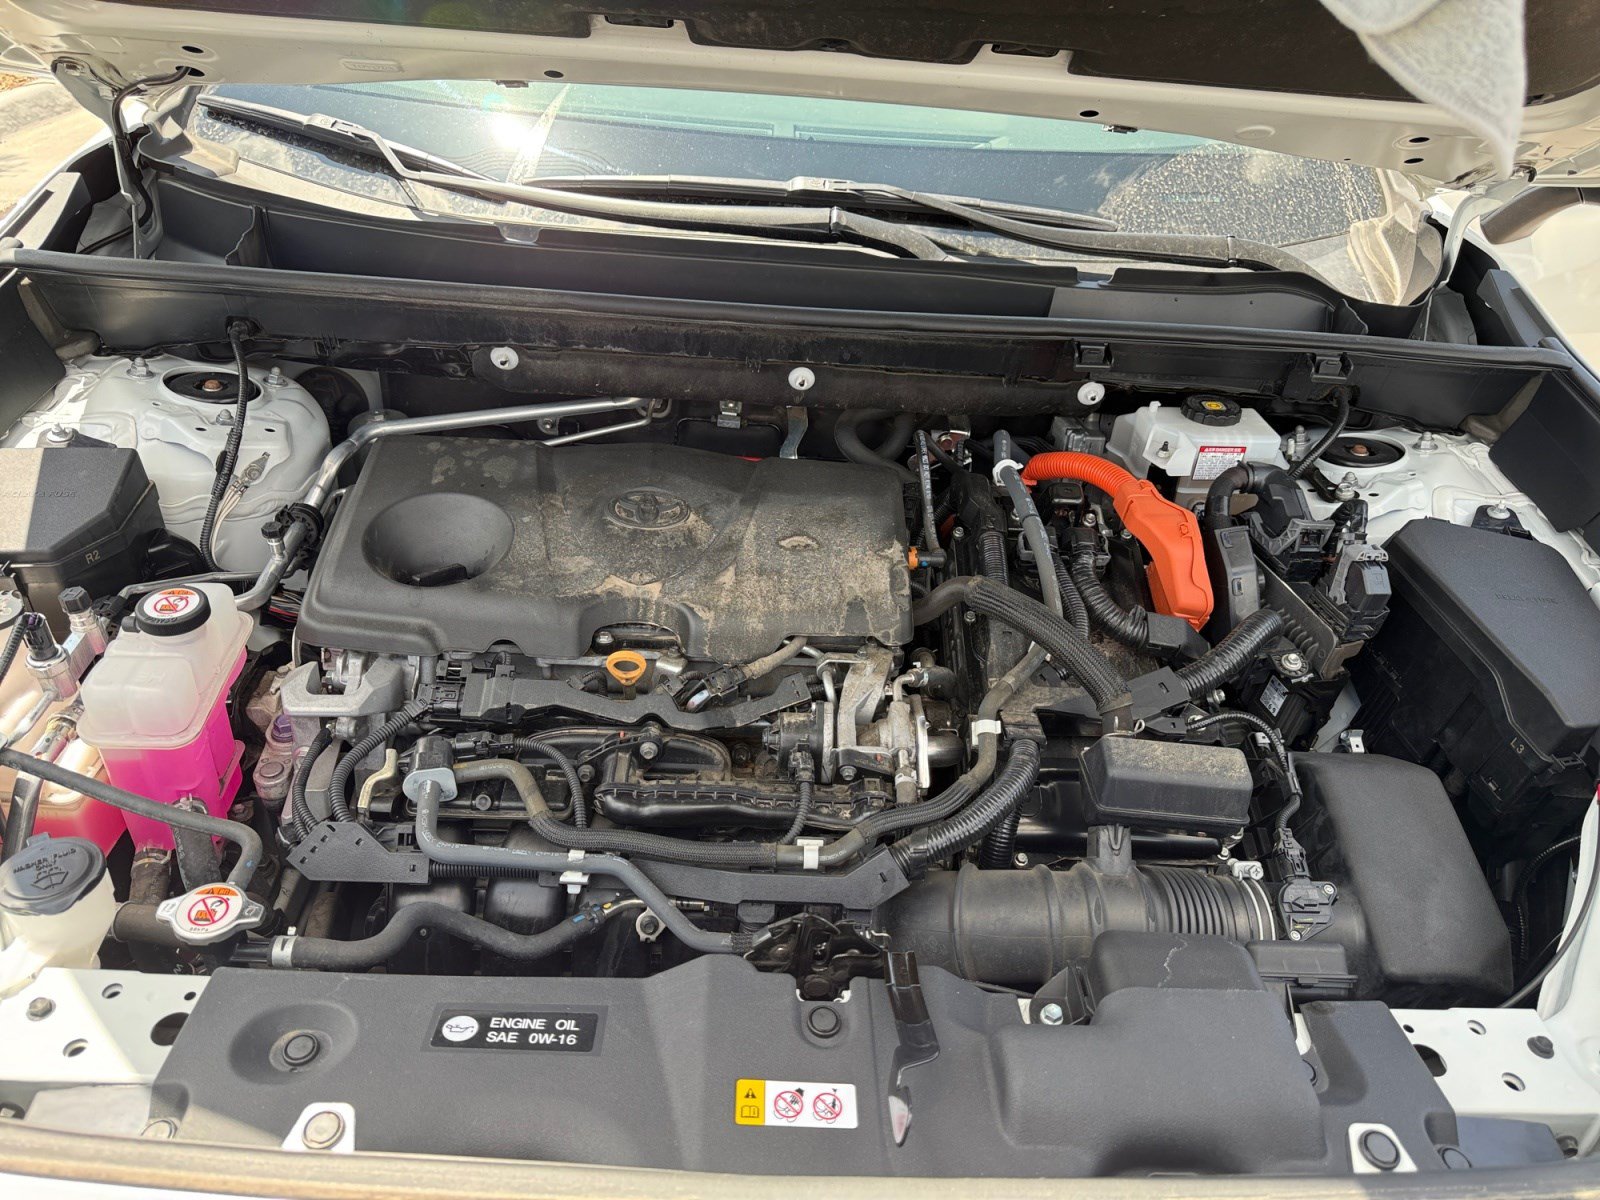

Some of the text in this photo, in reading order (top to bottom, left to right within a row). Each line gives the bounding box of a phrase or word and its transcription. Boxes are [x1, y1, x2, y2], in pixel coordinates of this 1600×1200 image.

[85, 549, 101, 564] R2
[1510, 737, 1525, 754] L3
[489, 1017, 580, 1031] ENGINE OIL
[485, 1031, 577, 1046] SAE 0W-16
